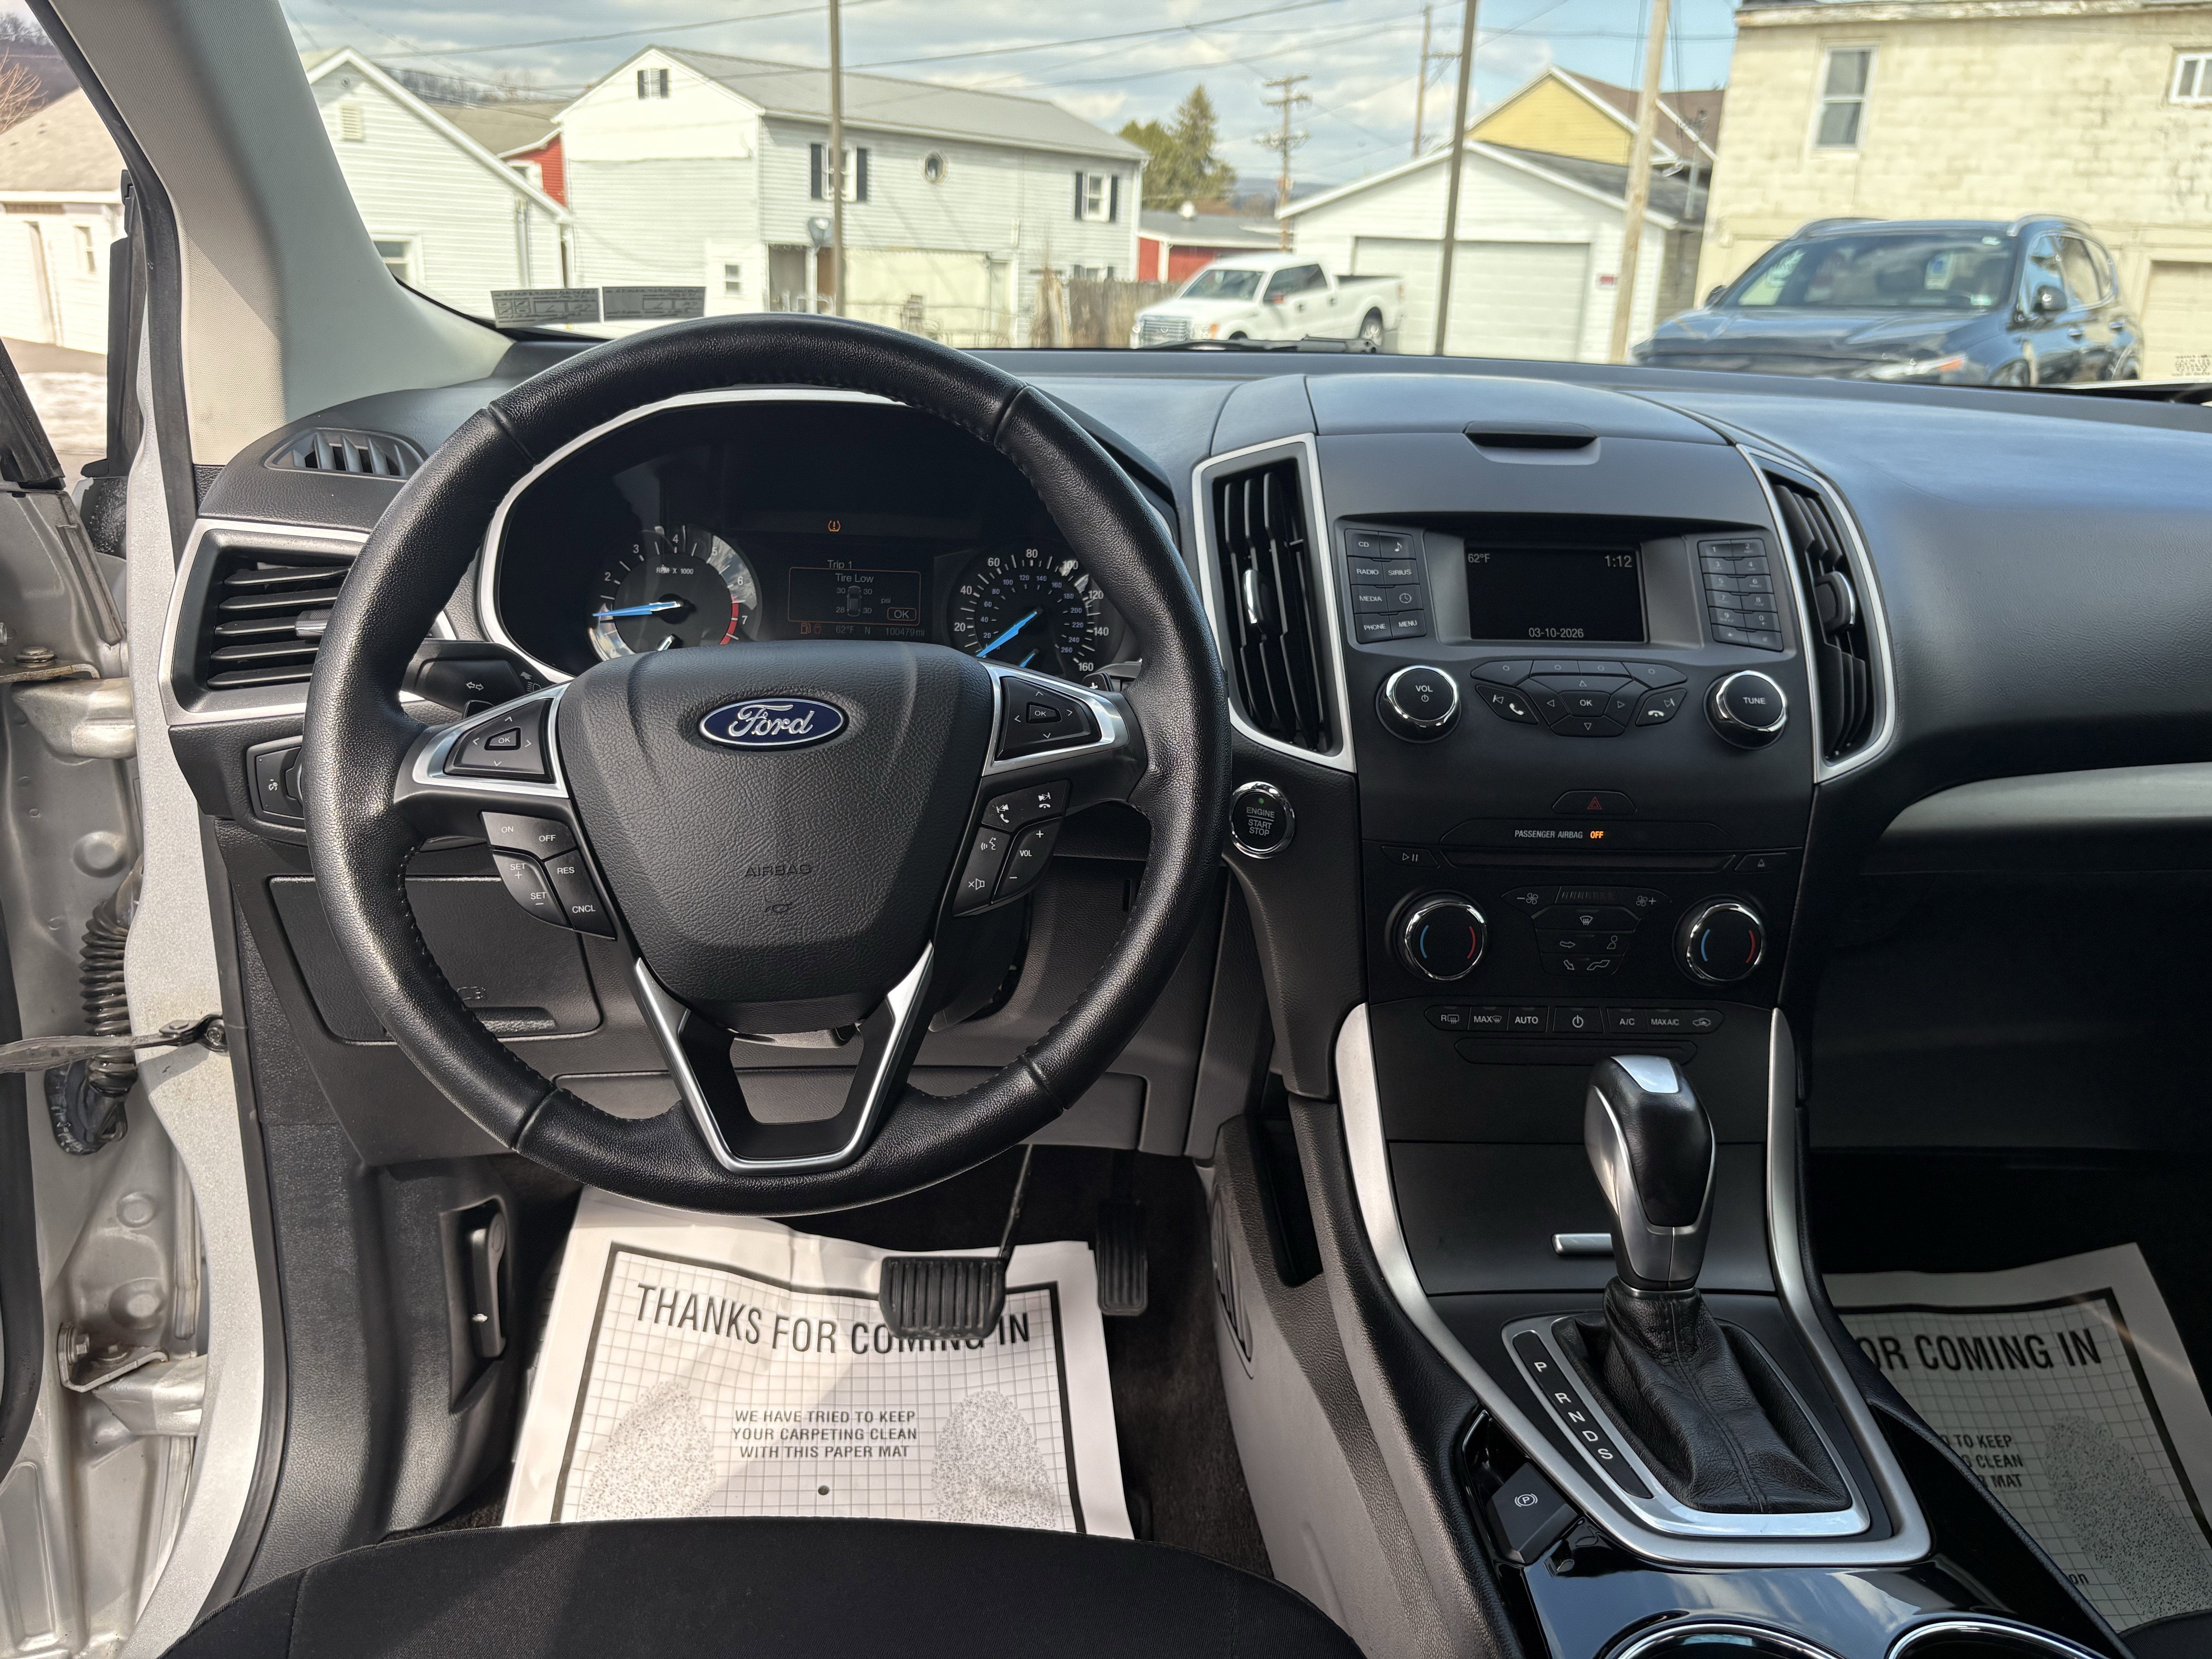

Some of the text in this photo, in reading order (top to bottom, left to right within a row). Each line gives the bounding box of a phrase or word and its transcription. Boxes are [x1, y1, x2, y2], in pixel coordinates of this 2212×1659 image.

[673, 534, 678, 543] 4
[633, 544, 639, 554] 3
[712, 547, 718, 556] 5
[1025, 549, 1038, 558] 80
[827, 560, 845, 570] Trip
[988, 558, 1000, 567] 60
[1063, 560, 1079, 570] 100
[1604, 555, 1633, 568] 1:12
[605, 573, 611, 581] 2
[737, 576, 744, 585] 6
[835, 573, 874, 583] Tire Low
[960, 586, 972, 595] 40
[1088, 591, 1104, 599] 120
[894, 610, 909, 619] OK
[742, 615, 748, 625] 7
[954, 623, 966, 632] 20
[1094, 627, 1109, 636] 140
[1528, 627, 1584, 638] 03-10-2026
[1078, 663, 1094, 672] 160
[728, 704, 815, 737] Ford
[1246, 807, 1275, 818] ENGINE
[1248, 819, 1272, 830] START
[1249, 827, 1270, 836] STOP
[1515, 830, 1604, 839] PASSENGER AIRBAG OFF
[745, 864, 811, 877] AIRBAG
[531, 892, 547, 900] SET
[572, 905, 596, 914] CNCL
[637, 1283, 763, 1345] THANKS
[772, 1314, 836, 1354] FOR
[999, 1312, 1029, 1345] IN
[1855, 1328, 2101, 1371] OR COMING IN
[1534, 1362, 1613, 1459] P R N D S
[735, 1410, 916, 1423] WE HAVE TRIED TO KEEP
[732, 1428, 917, 1441] YOUR CARPETING CLEAN
[1953, 1434, 1974, 1448] TO
[1976, 1434, 2013, 1449] KEEP
[740, 1445, 910, 1458] WITH THIS PAPER MAT
[1975, 1454, 2024, 1468] CLEAN
[1993, 1474, 2023, 1488] MAT
